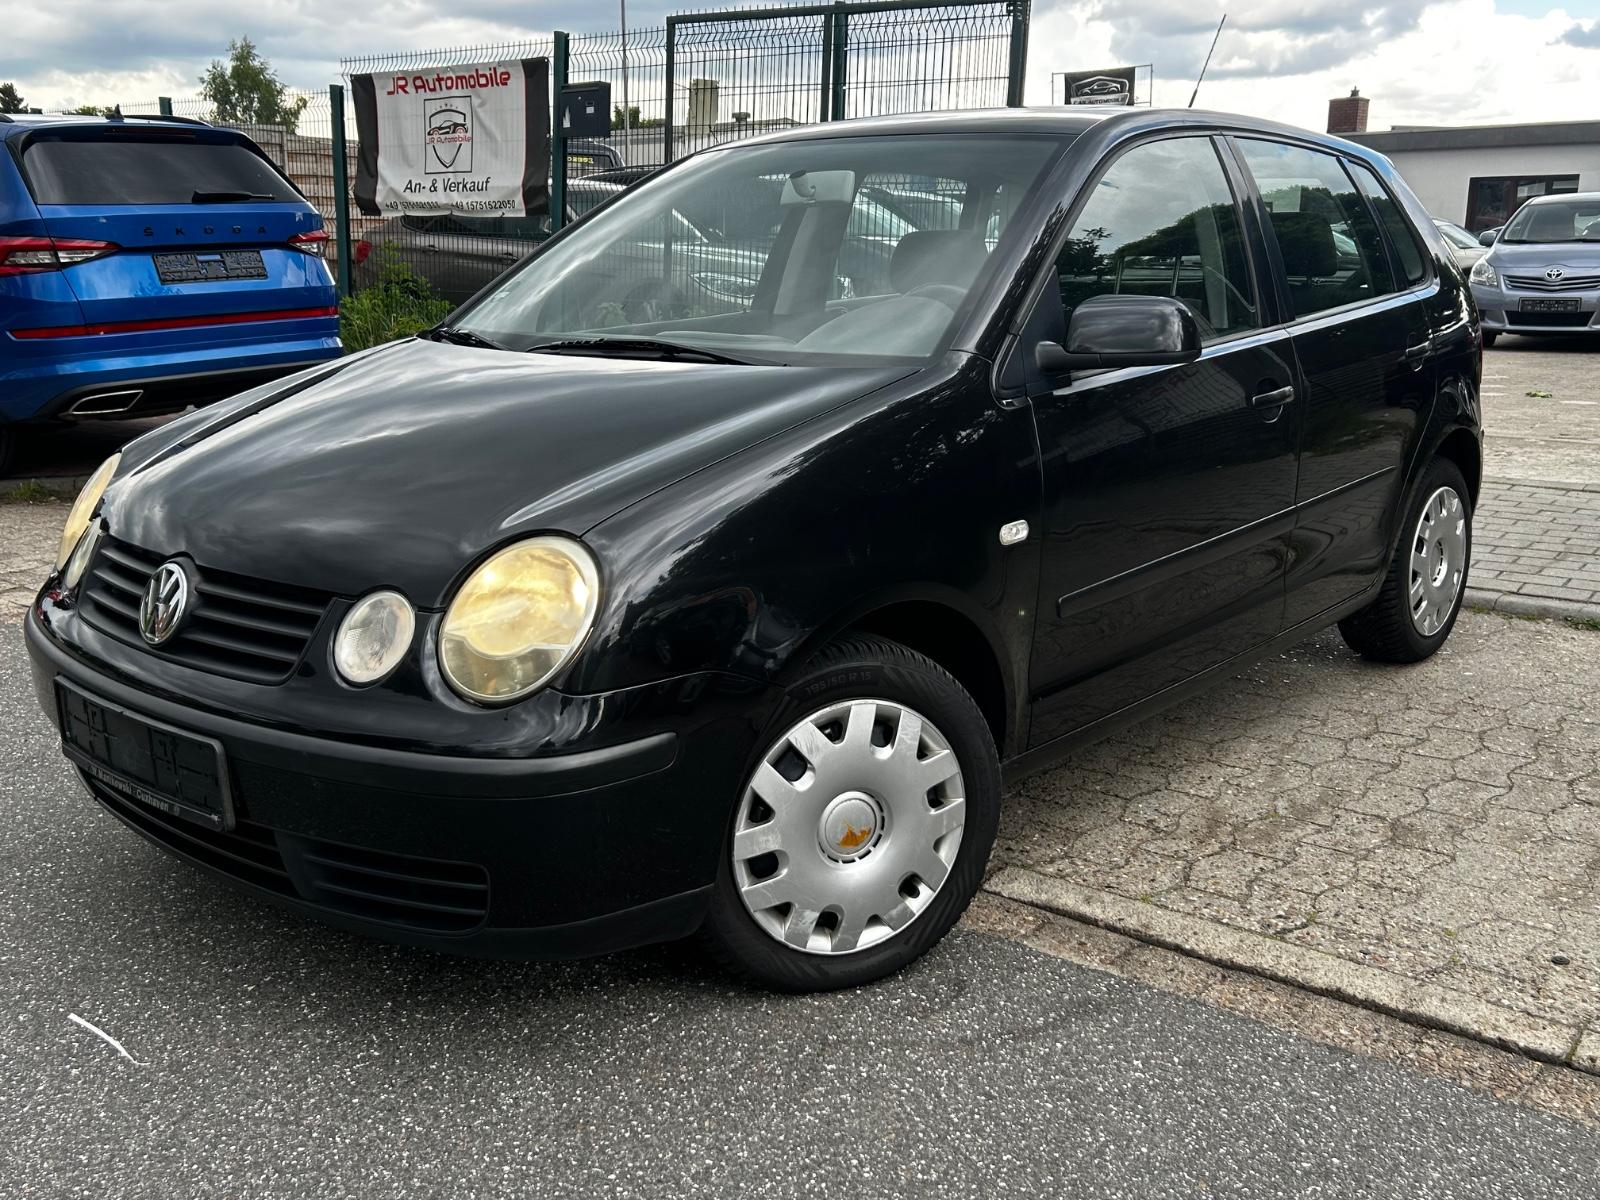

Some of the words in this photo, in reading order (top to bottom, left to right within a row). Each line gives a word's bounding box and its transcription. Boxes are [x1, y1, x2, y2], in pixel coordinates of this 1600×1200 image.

[387, 75, 409, 96] JR
[412, 67, 511, 94] Automobile
[403, 179, 426, 193] An-
[429, 178, 438, 193] &
[442, 177, 491, 193] Verkauf
[385, 200, 399, 210] +49
